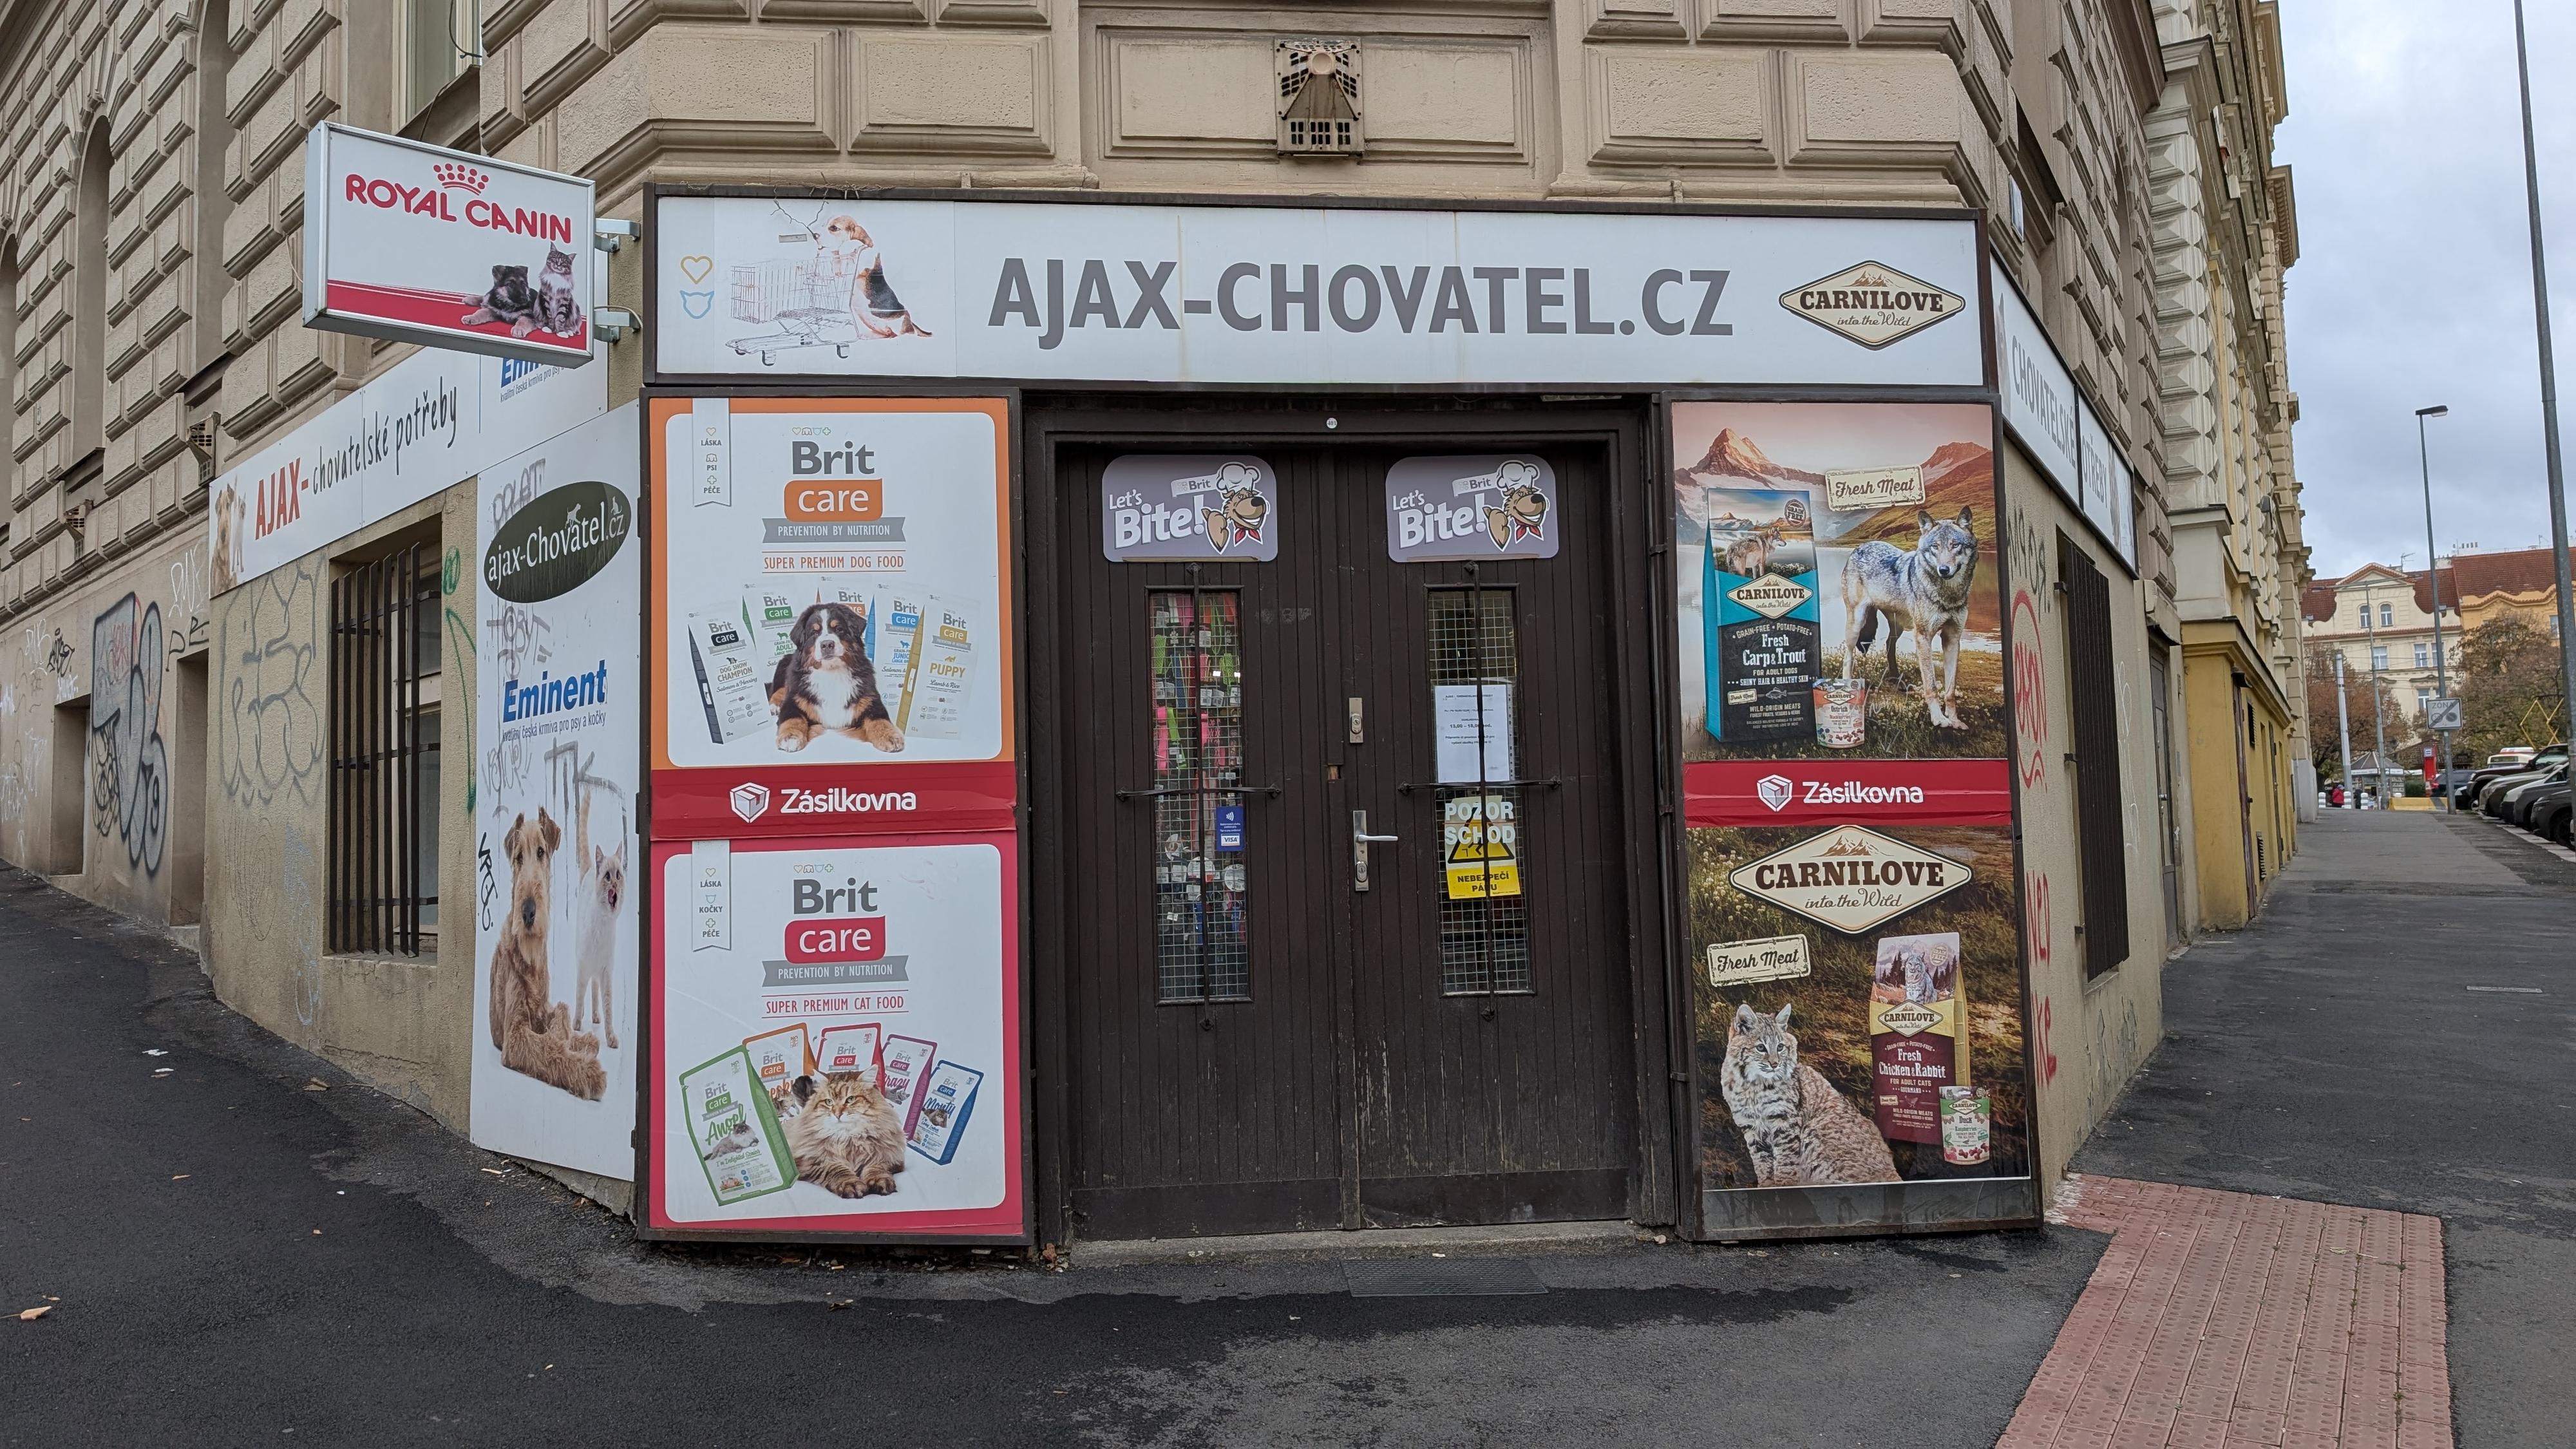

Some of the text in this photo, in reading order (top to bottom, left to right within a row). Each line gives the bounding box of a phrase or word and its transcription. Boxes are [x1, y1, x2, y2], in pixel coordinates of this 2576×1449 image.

[345, 174, 571, 243] ROYAL CANIN
[989, 258, 1732, 349] AJAX-CHOVATEL.CZ
[1800, 290, 1943, 312] CARNILOVE
[1837, 311, 1911, 326] into the Wild
[2012, 335, 2076, 469] CHOVATELSKÉ
[2082, 433, 2108, 509] OTŘEBY
[312, 412, 389, 495] chovatelské
[396, 376, 457, 475] potřeby
[701, 438, 722, 446] LÁSKA
[793, 440, 875, 475] Brit
[703, 486, 720, 494] PÉČE
[1188, 479, 1211, 491] Brit
[1469, 477, 1492, 489] Brit
[1835, 478, 1915, 498] Fresh Meat
[798, 489, 869, 512] care
[1109, 489, 1142, 510] Let's
[1393, 489, 1425, 510] Let's
[1115, 495, 1204, 549] Bite!
[1399, 493, 1486, 549] Bite!
[778, 525, 890, 536] PREVENTION BY NUTRITION
[489, 502, 624, 590] ajax-Chovatel.cz
[764, 556, 904, 569] SUPER PREMIUM DOG FOOD
[763, 595, 788, 607] Brit
[838, 591, 862, 602] Brit
[1737, 588, 1804, 600] CARNILOVE
[893, 600, 917, 614] Brit
[1776, 600, 1791, 608] Wild
[769, 609, 789, 618] care
[896, 615, 916, 625] care
[943, 612, 967, 629] Brit
[708, 621, 734, 633] Brit
[944, 629, 963, 639] care
[1736, 623, 1810, 638] GRAIN-FREE POTATO-FREE
[715, 633, 735, 643] care
[1761, 634, 1789, 647] Fresh
[733, 661, 747, 670] SHOW
[929, 663, 965, 678] PUPPY
[717, 666, 752, 682] CHAMPION
[503, 659, 607, 723] Eminent
[522, 723, 537, 738] česká
[538, 721, 558, 735] krmiva
[559, 720, 569, 734] pro
[571, 717, 581, 732] psy
[583, 717, 587, 726] a
[588, 710, 606, 726] kočky
[1803, 781, 1924, 804] Zásilkovna
[781, 788, 916, 814] Zásilkovna
[1445, 801, 1513, 820] POZOR
[1444, 826, 1515, 845] SCHOD
[1756, 860, 1944, 889] CARNILOVE
[700, 879, 722, 888] LÁSKA
[1472, 882, 1497, 892] PÁU
[793, 877, 878, 914] Brit
[1805, 887, 1902, 909] into the Wild
[699, 904, 723, 914] KOČKY
[702, 929, 720, 938] PÉČE
[799, 927, 871, 953] care
[1718, 949, 1799, 972] Fresh Meat
[778, 965, 893, 980] PREVENTION BY NUTRITION
[766, 996, 904, 1014] SUPER PREMIUM CAT FOOD
[1884, 1013, 1935, 1022] CARNILOVE
[837, 1046, 856, 1054] Brit
[895, 1053, 912, 1062] Brit
[1898, 1048, 1922, 1061] Fresh
[762, 1053, 783, 1065] Brit
[764, 1065, 782, 1075] care
[885, 1074, 910, 1092] razy
[940, 1086, 953, 1095] care
[943, 1078, 958, 1088] Brit
[705, 1083, 727, 1099] Brit
[709, 1097, 728, 1110] care
